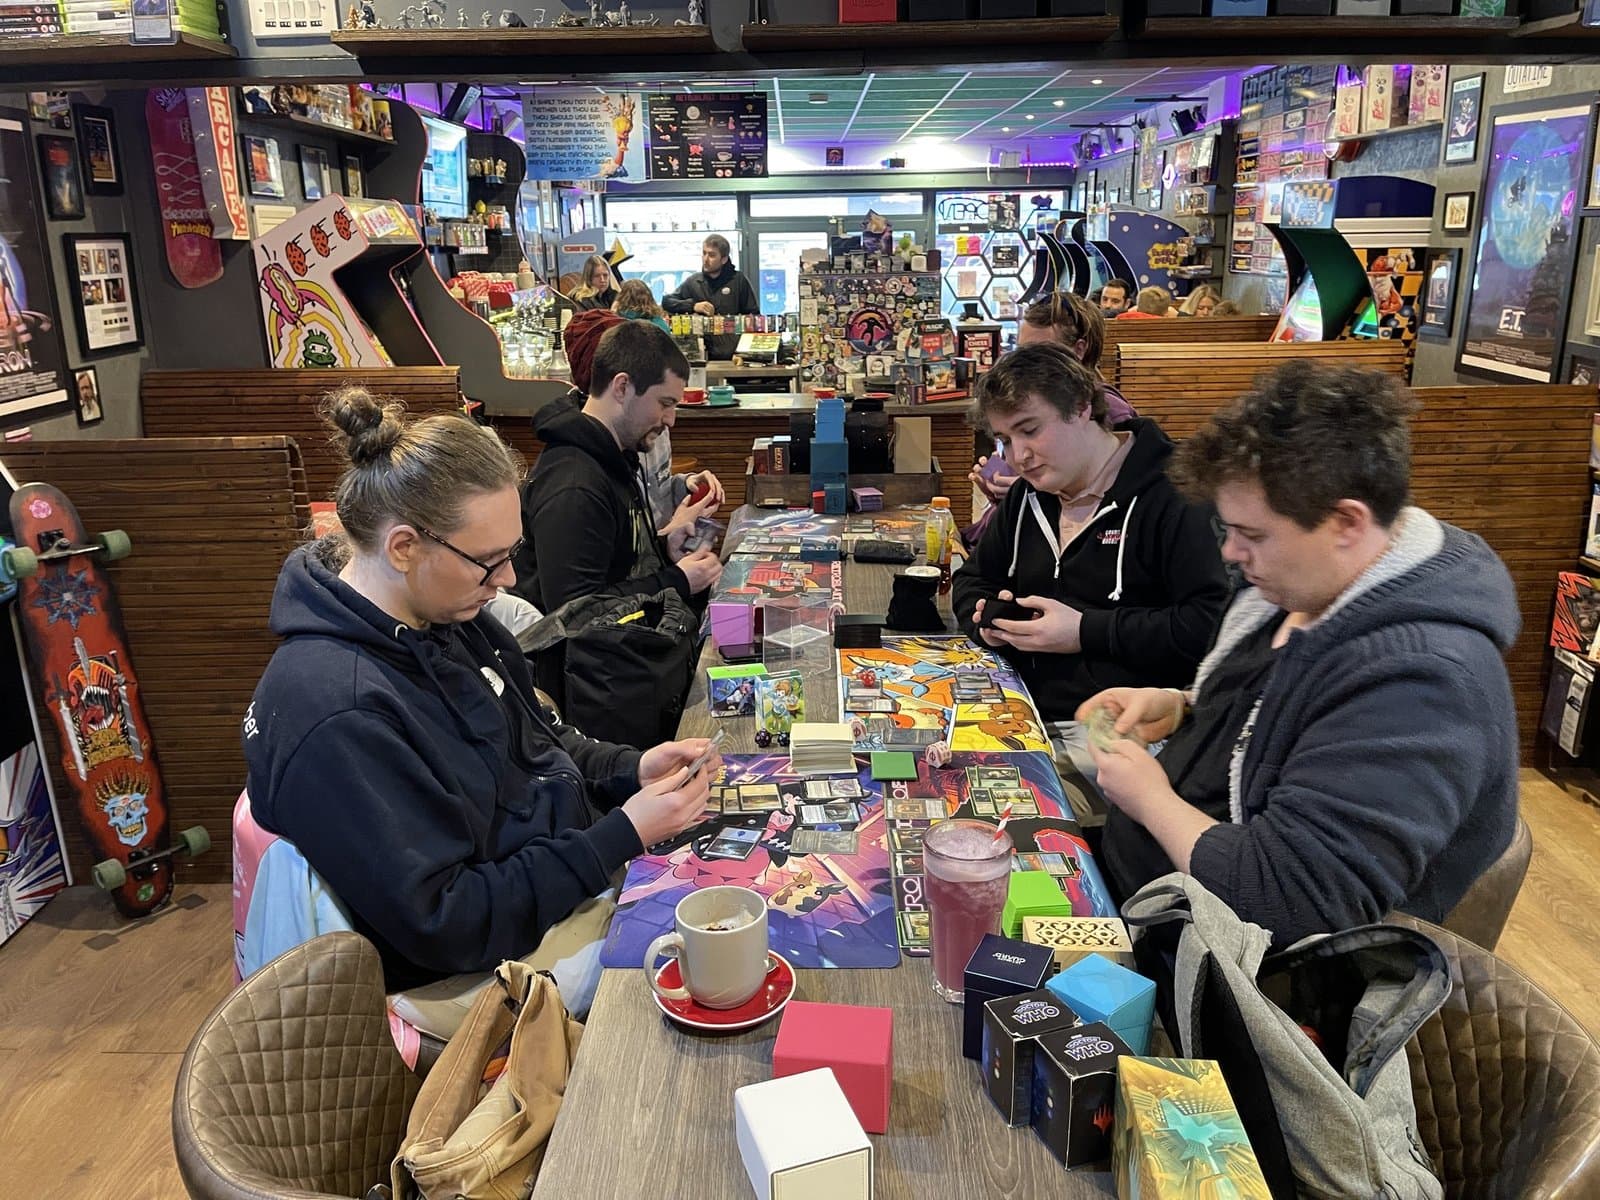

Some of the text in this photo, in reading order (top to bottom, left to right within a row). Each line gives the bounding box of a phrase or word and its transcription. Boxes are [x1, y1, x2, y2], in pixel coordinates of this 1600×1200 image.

[0, 349, 32, 373] RON
[1011, 1005, 1061, 1025] WHO
[1064, 1041, 1115, 1061] WHO
